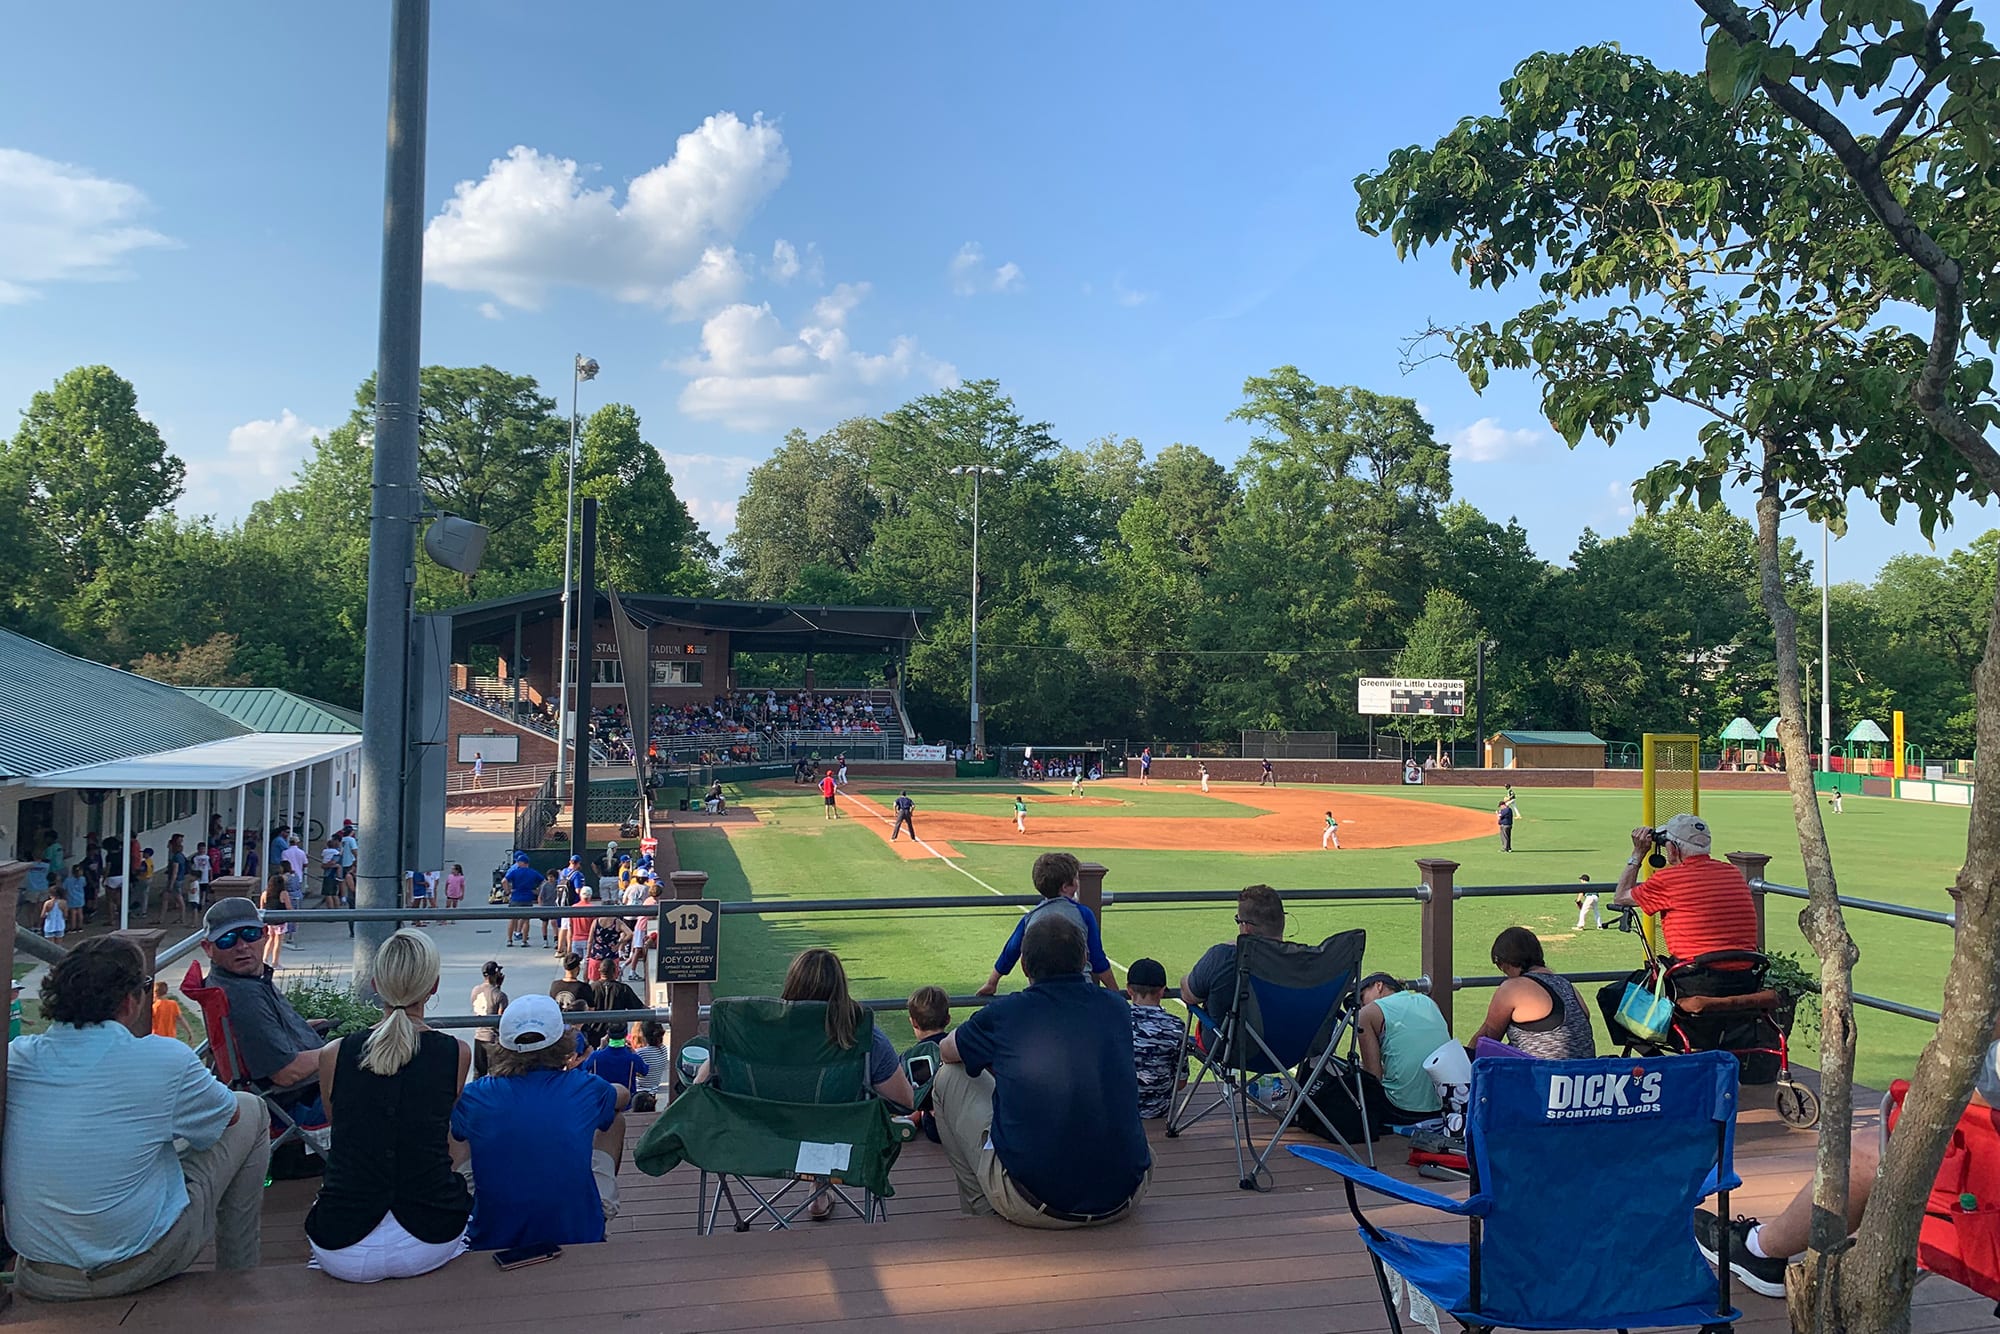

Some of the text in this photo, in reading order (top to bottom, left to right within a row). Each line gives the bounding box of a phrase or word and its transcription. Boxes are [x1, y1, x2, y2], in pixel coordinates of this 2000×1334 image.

[1360, 679, 1463, 689] Greenville Little Leagues
[680, 913, 699, 930] 13
[661, 955, 714, 964] JOEY OVERBY
[1548, 1070, 1662, 1109] DICK'S
[1546, 1104, 1661, 1119] SPORTING GOODS
